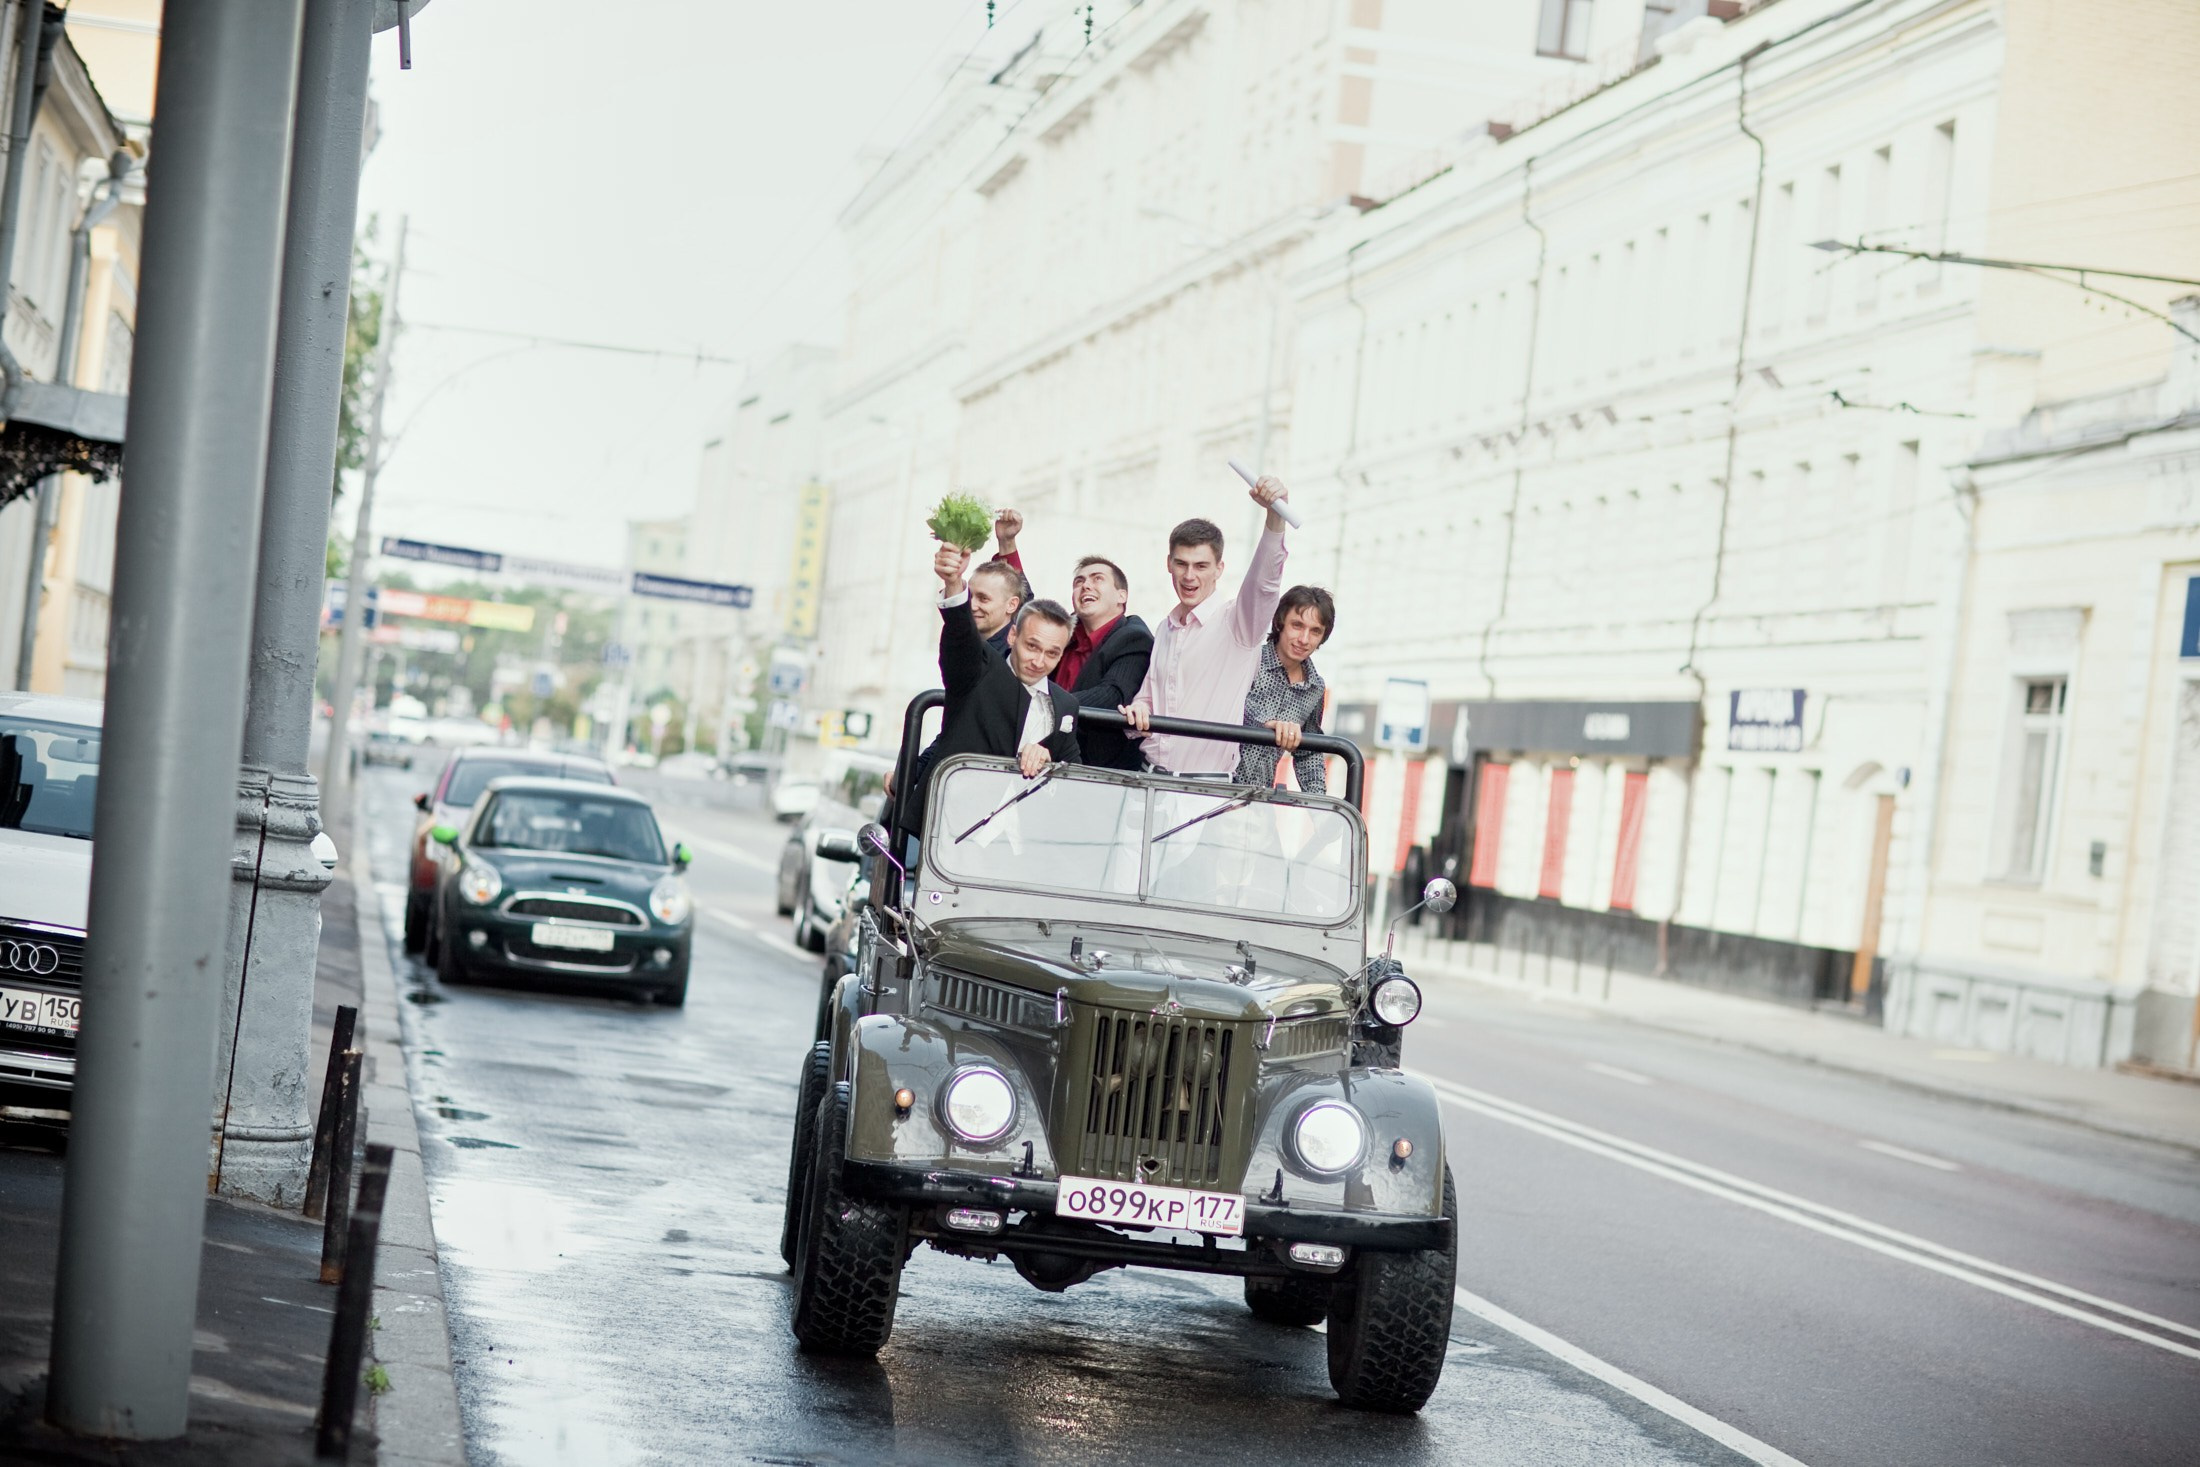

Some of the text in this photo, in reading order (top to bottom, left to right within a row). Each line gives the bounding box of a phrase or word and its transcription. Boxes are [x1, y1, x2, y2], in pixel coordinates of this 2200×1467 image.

[0, 992, 82, 1021] УВ 150
[24, 1024, 36, 1032] 797
[50, 1018, 70, 1028] RUS
[1193, 1196, 1236, 1220] 177
[1200, 1219, 1222, 1229] RUS
